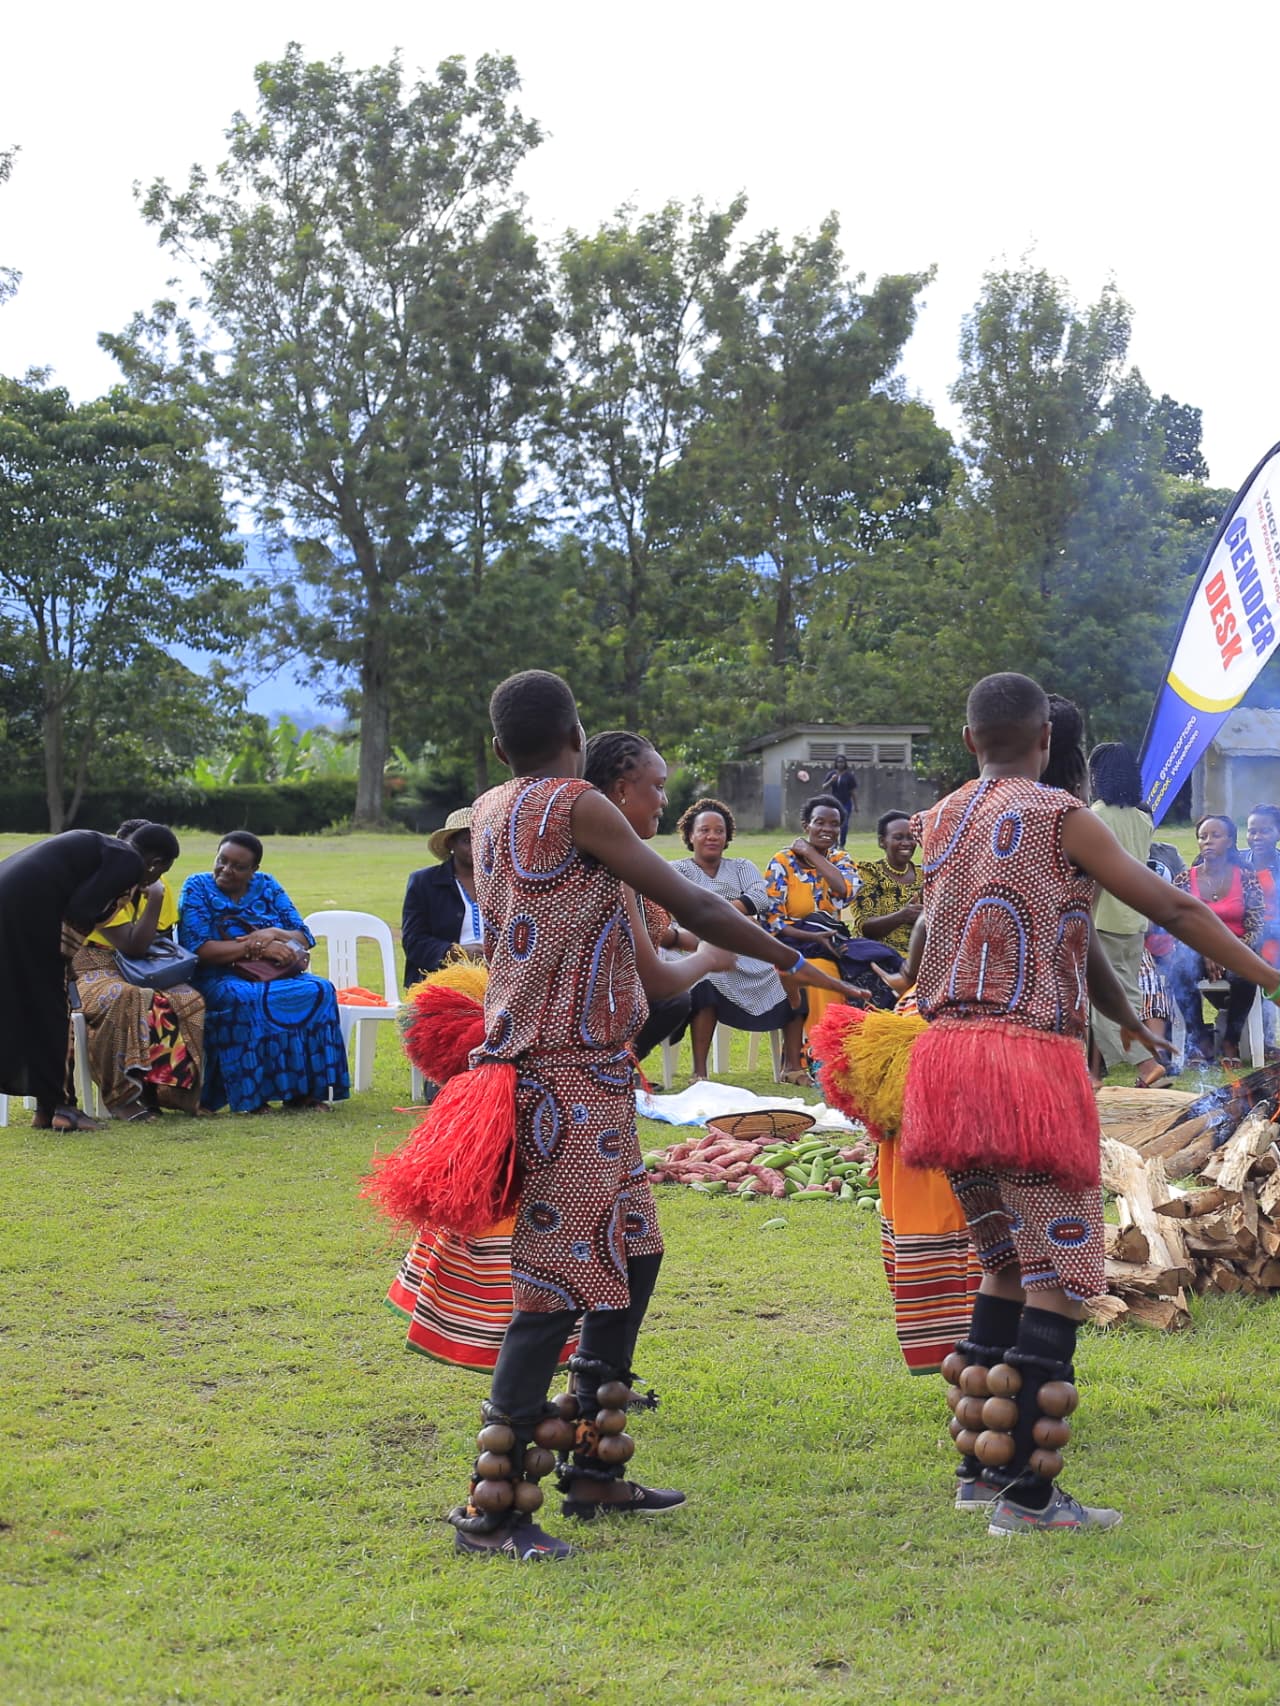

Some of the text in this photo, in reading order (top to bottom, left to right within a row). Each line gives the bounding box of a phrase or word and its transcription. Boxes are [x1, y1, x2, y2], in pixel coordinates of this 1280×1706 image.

[1256, 498, 1265, 521] THE
[1261, 524, 1276, 575] PEOPLE'S
[1263, 489, 1278, 540] VOICE
[1205, 569, 1243, 672] DESK
[1224, 516, 1276, 657] GENDER
